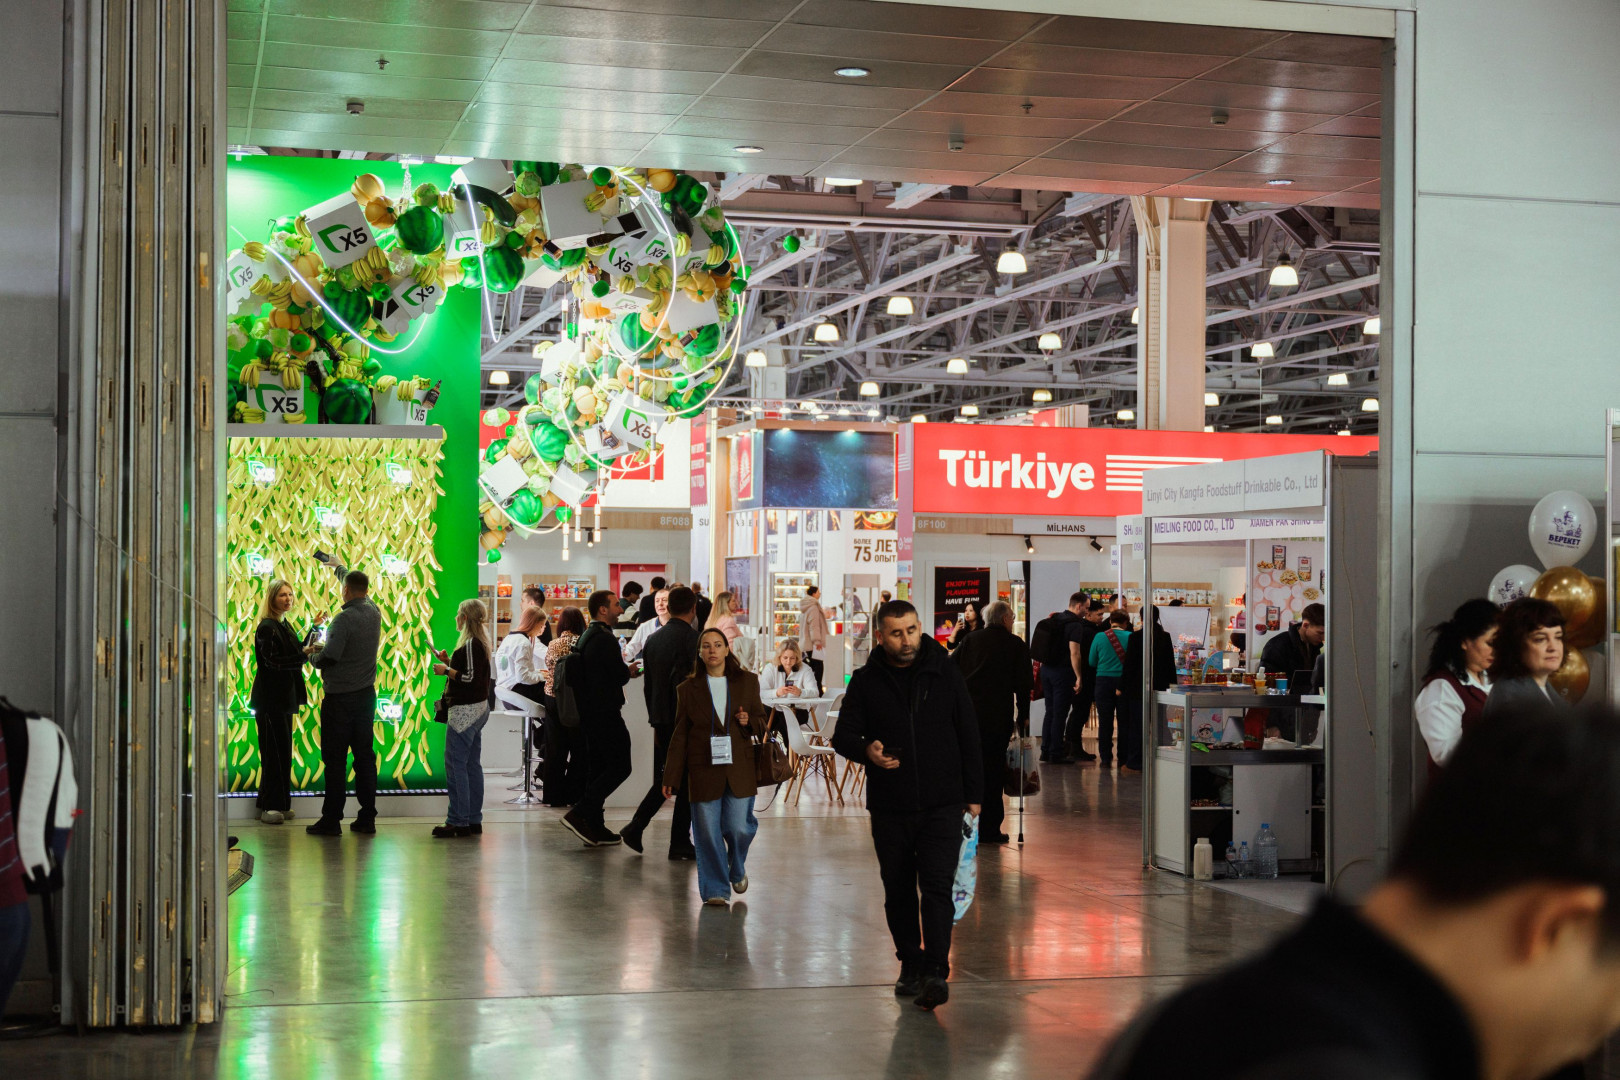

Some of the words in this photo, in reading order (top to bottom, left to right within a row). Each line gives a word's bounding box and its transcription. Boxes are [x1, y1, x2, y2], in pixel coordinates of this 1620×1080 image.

[339, 227, 368, 251] X5
[648, 247, 666, 258] X5
[613, 256, 634, 273] X5
[238, 268, 253, 286] X5
[416, 284, 435, 303] X5
[271, 396, 298, 414] X5
[414, 408, 426, 422] X5
[629, 420, 652, 440] X5
[938, 449, 1095, 499] Türkiye
[1147, 489, 1162, 504] Linyi
[1164, 487, 1177, 503] City
[1179, 485, 1204, 502] Kangfa
[1206, 481, 1242, 497] Foodstuff
[1244, 477, 1281, 494] Drinkable
[1284, 476, 1301, 492] Co.,
[1304, 474, 1318, 489] Ltd
[917, 519, 946, 529] 8F100
[1046, 523, 1086, 533] MİLHANS
[1154, 522, 1181, 534] MEILING
[1183, 520, 1201, 532] FOOD
[1221, 518, 1235, 530] LTD
[1548, 534, 1581, 546] БЕРЕКЕТ
[853, 546, 872, 562] 75
[875, 539, 898, 553] ЛЕТ
[945, 580, 966, 588] ENJOY
[946, 588, 979, 596] FLAVOURS
[945, 597, 963, 605] HAVE
